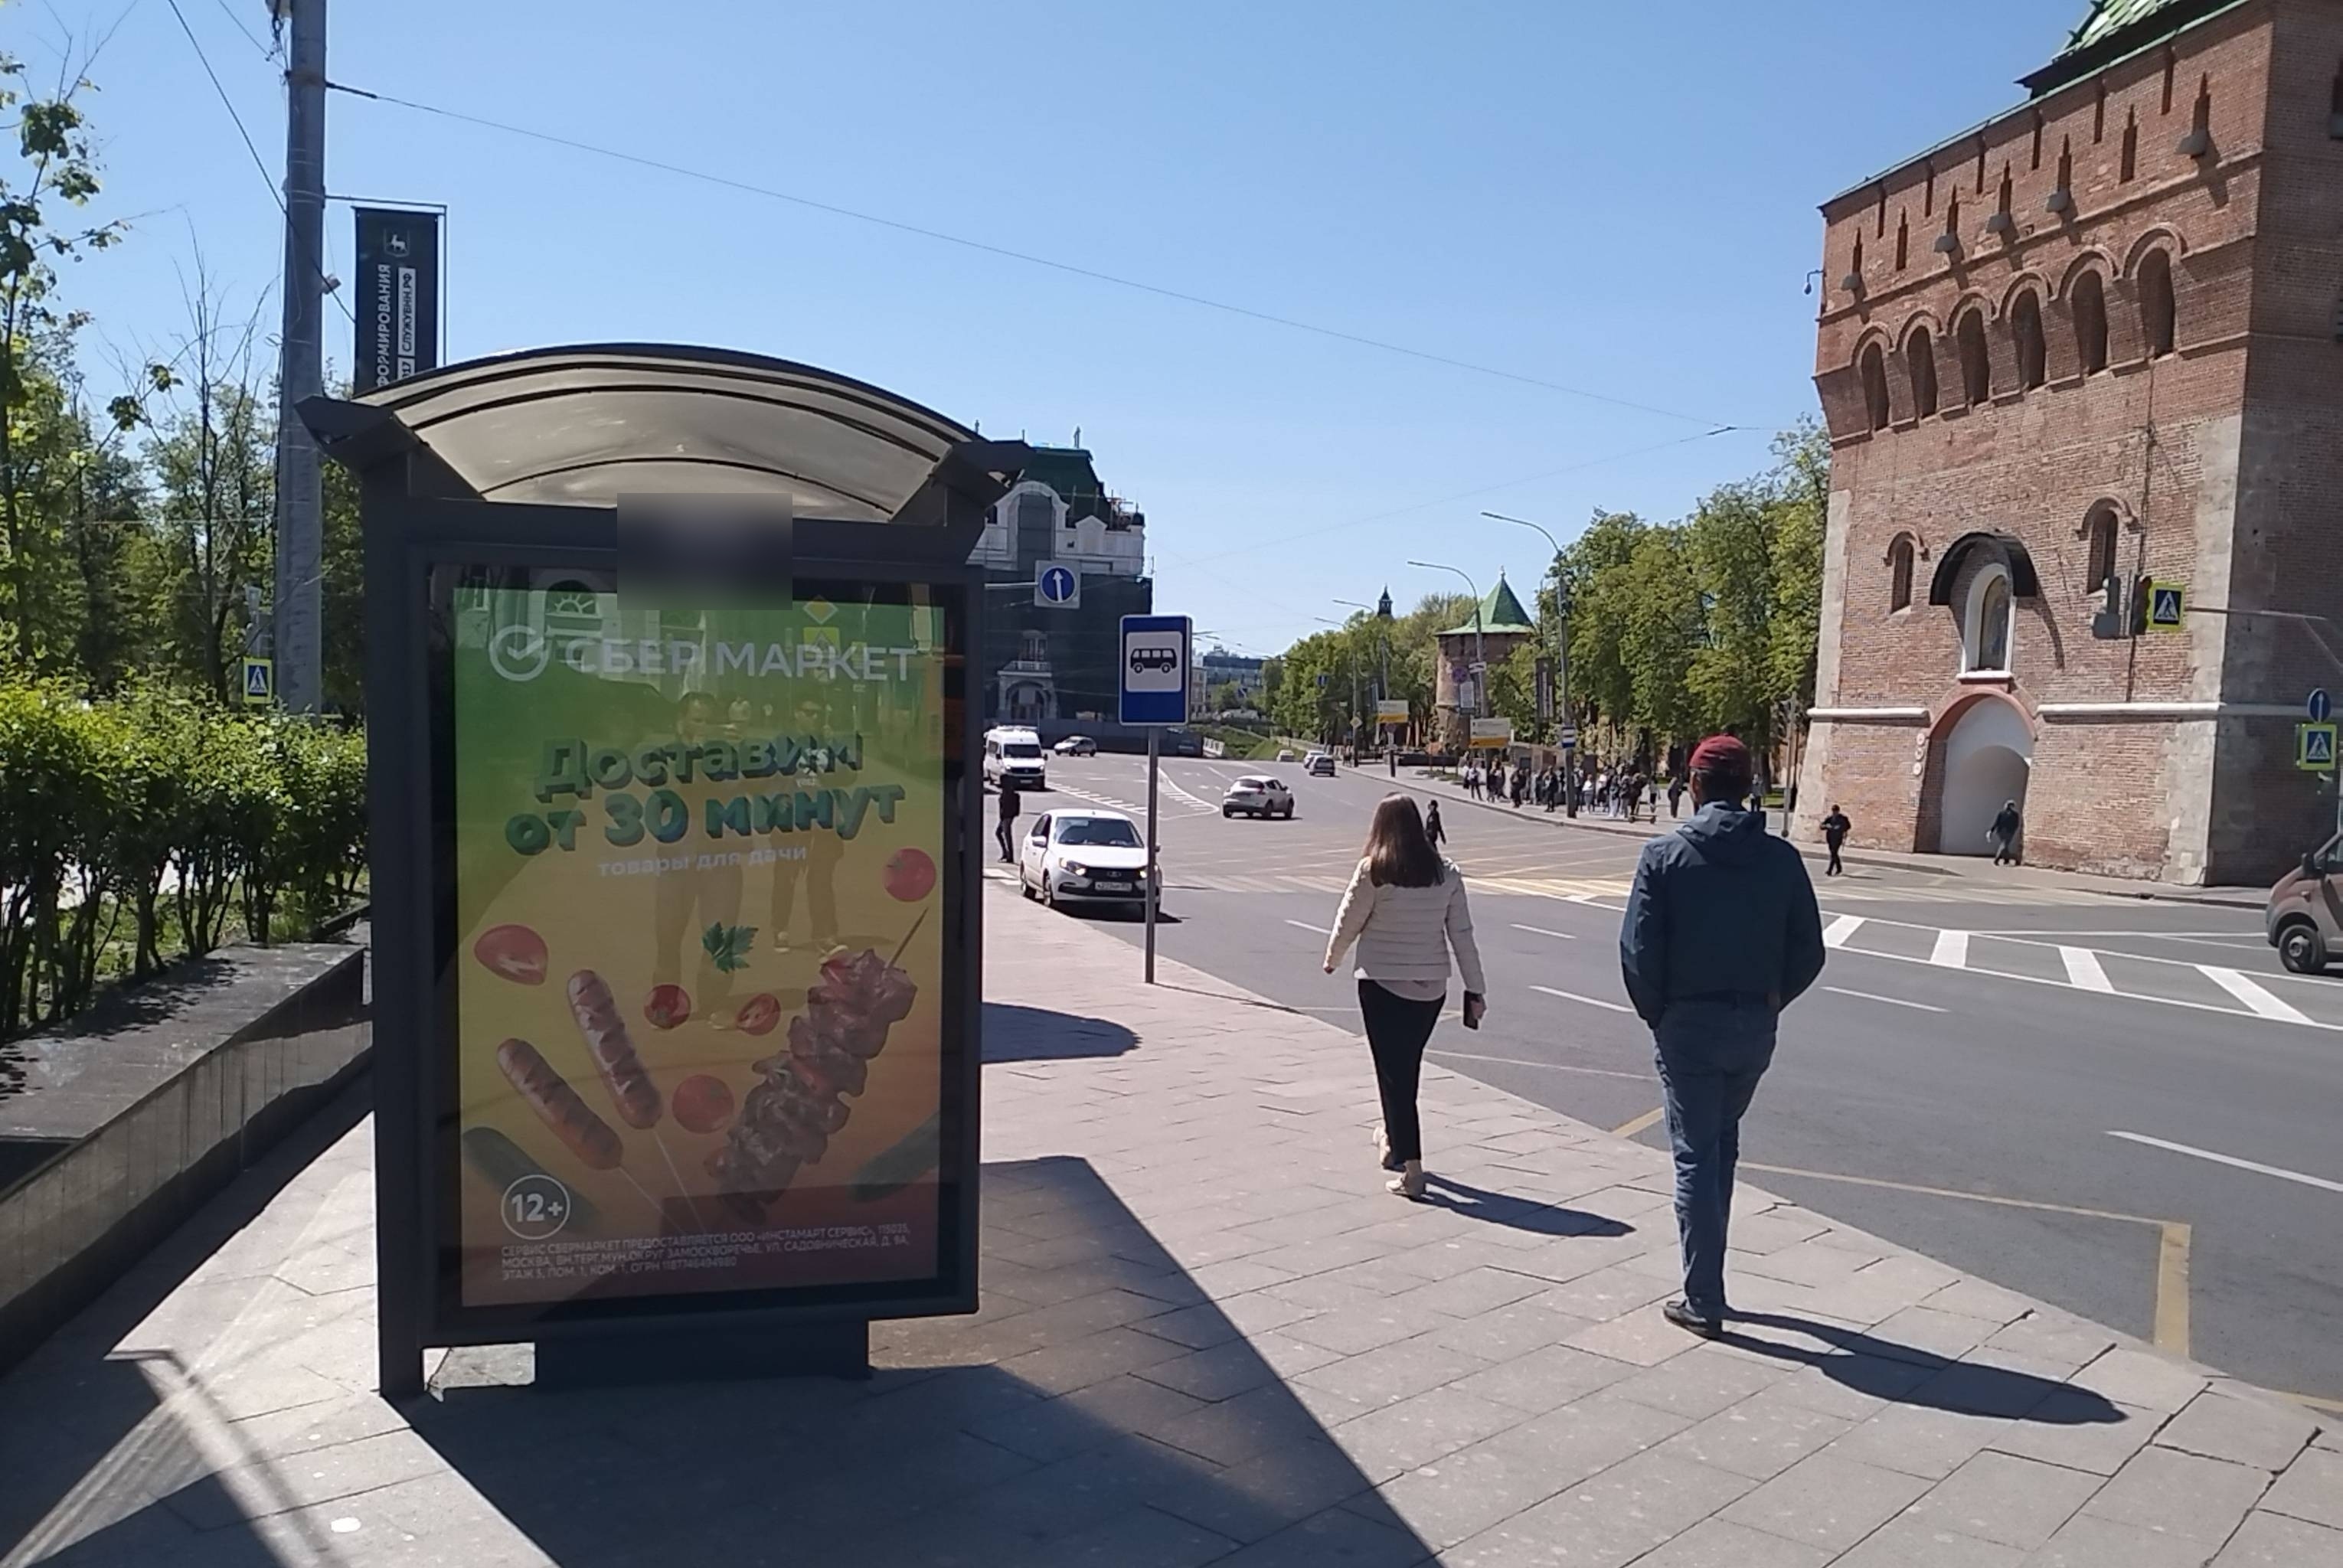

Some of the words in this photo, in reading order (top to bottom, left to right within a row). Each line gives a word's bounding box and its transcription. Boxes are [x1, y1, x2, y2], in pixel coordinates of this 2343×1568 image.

[715, 642, 917, 681] МАРКЕТ
[534, 731, 864, 803] Доставим
[505, 809, 587, 856] от
[605, 789, 688, 848] 30
[705, 783, 906, 841] минут
[598, 856, 689, 877] товары
[697, 851, 741, 871] для
[748, 846, 806, 866] дачи
[511, 1193, 564, 1223] 12+
[502, 1244, 546, 1257] СЕРВИС
[547, 1240, 620, 1253] СБЕРМАРКЕТ
[623, 1233, 727, 1250] ПРЕДОСТАВЛЯЕТСЯ
[730, 1231, 754, 1243] ООО
